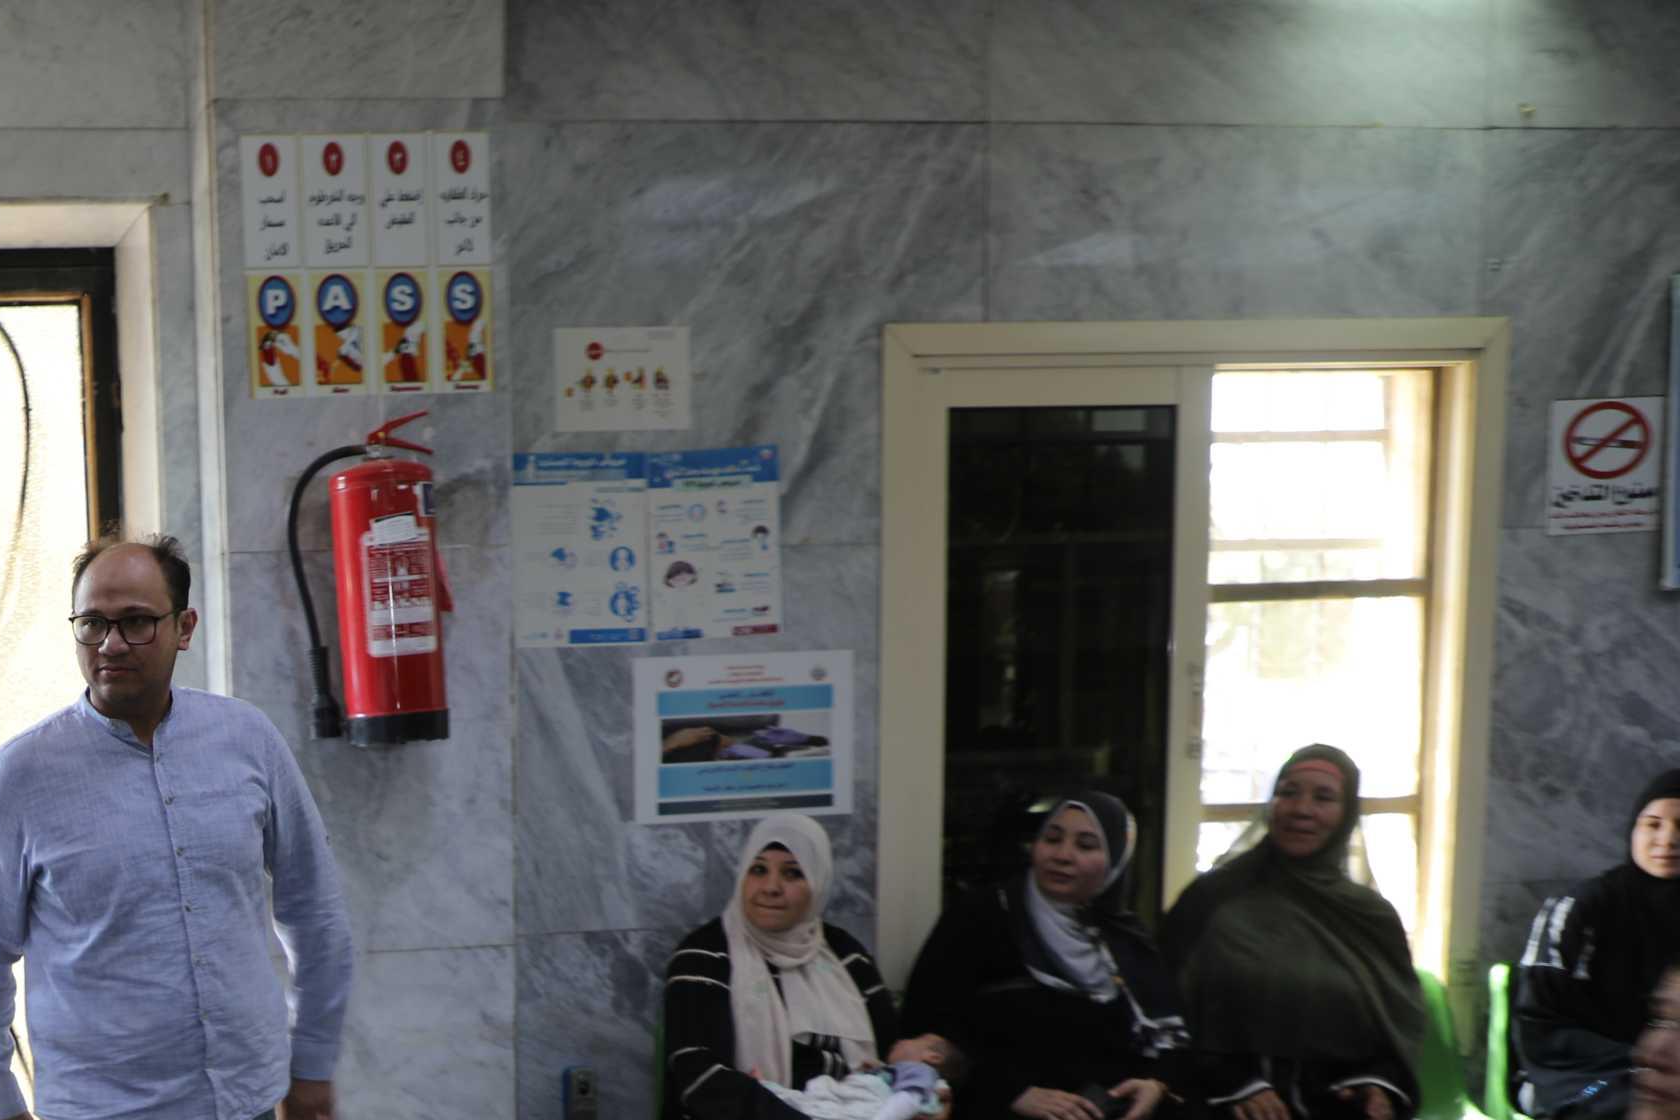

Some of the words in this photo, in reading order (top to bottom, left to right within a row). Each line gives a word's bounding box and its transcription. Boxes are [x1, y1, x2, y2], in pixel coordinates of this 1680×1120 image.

[266, 289, 288, 315] P
[321, 285, 351, 311] A
[390, 284, 415, 311] S
[452, 283, 476, 310] S
